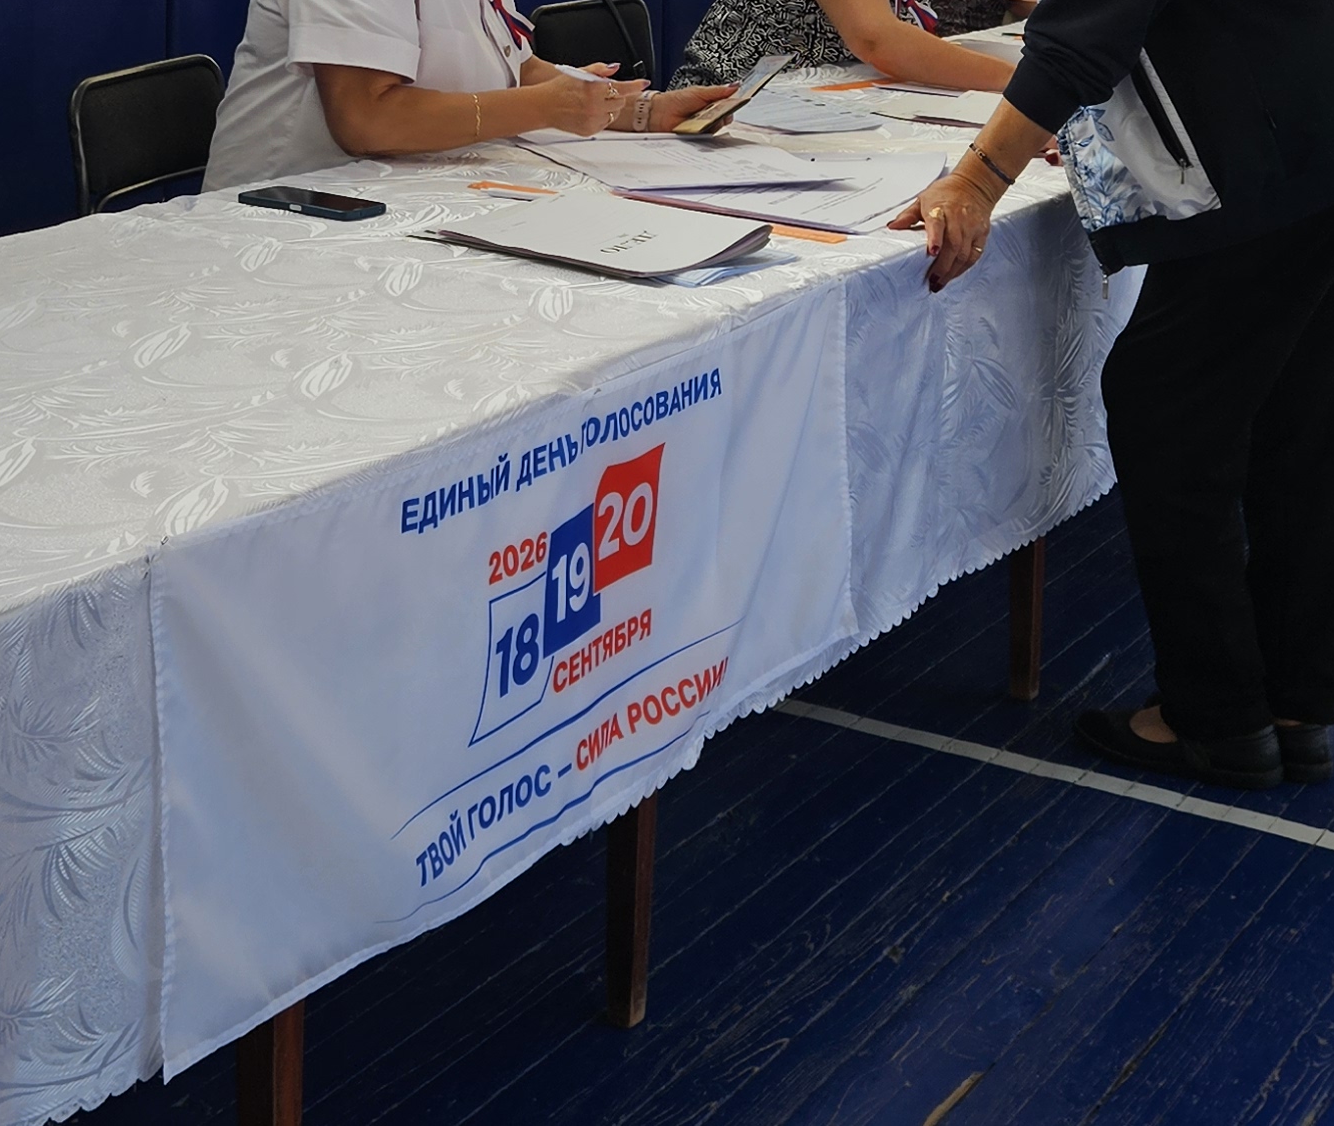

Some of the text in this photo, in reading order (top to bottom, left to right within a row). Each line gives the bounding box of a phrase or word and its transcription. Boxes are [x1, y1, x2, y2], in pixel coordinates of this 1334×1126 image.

[401, 368, 722, 535] ЕДИНЫЙ ДЕНЬ ГОЛОСОВАНИЯ
[489, 532, 548, 584] 2026
[598, 481, 653, 562] 20
[552, 541, 591, 623] 19
[496, 613, 539, 698] 18
[553, 608, 652, 694] СЕНТЯБРЯ
[416, 809, 467, 887] ТВОЙ
[469, 764, 551, 839] ГОЛОС
[576, 715, 622, 772] СИЛА
